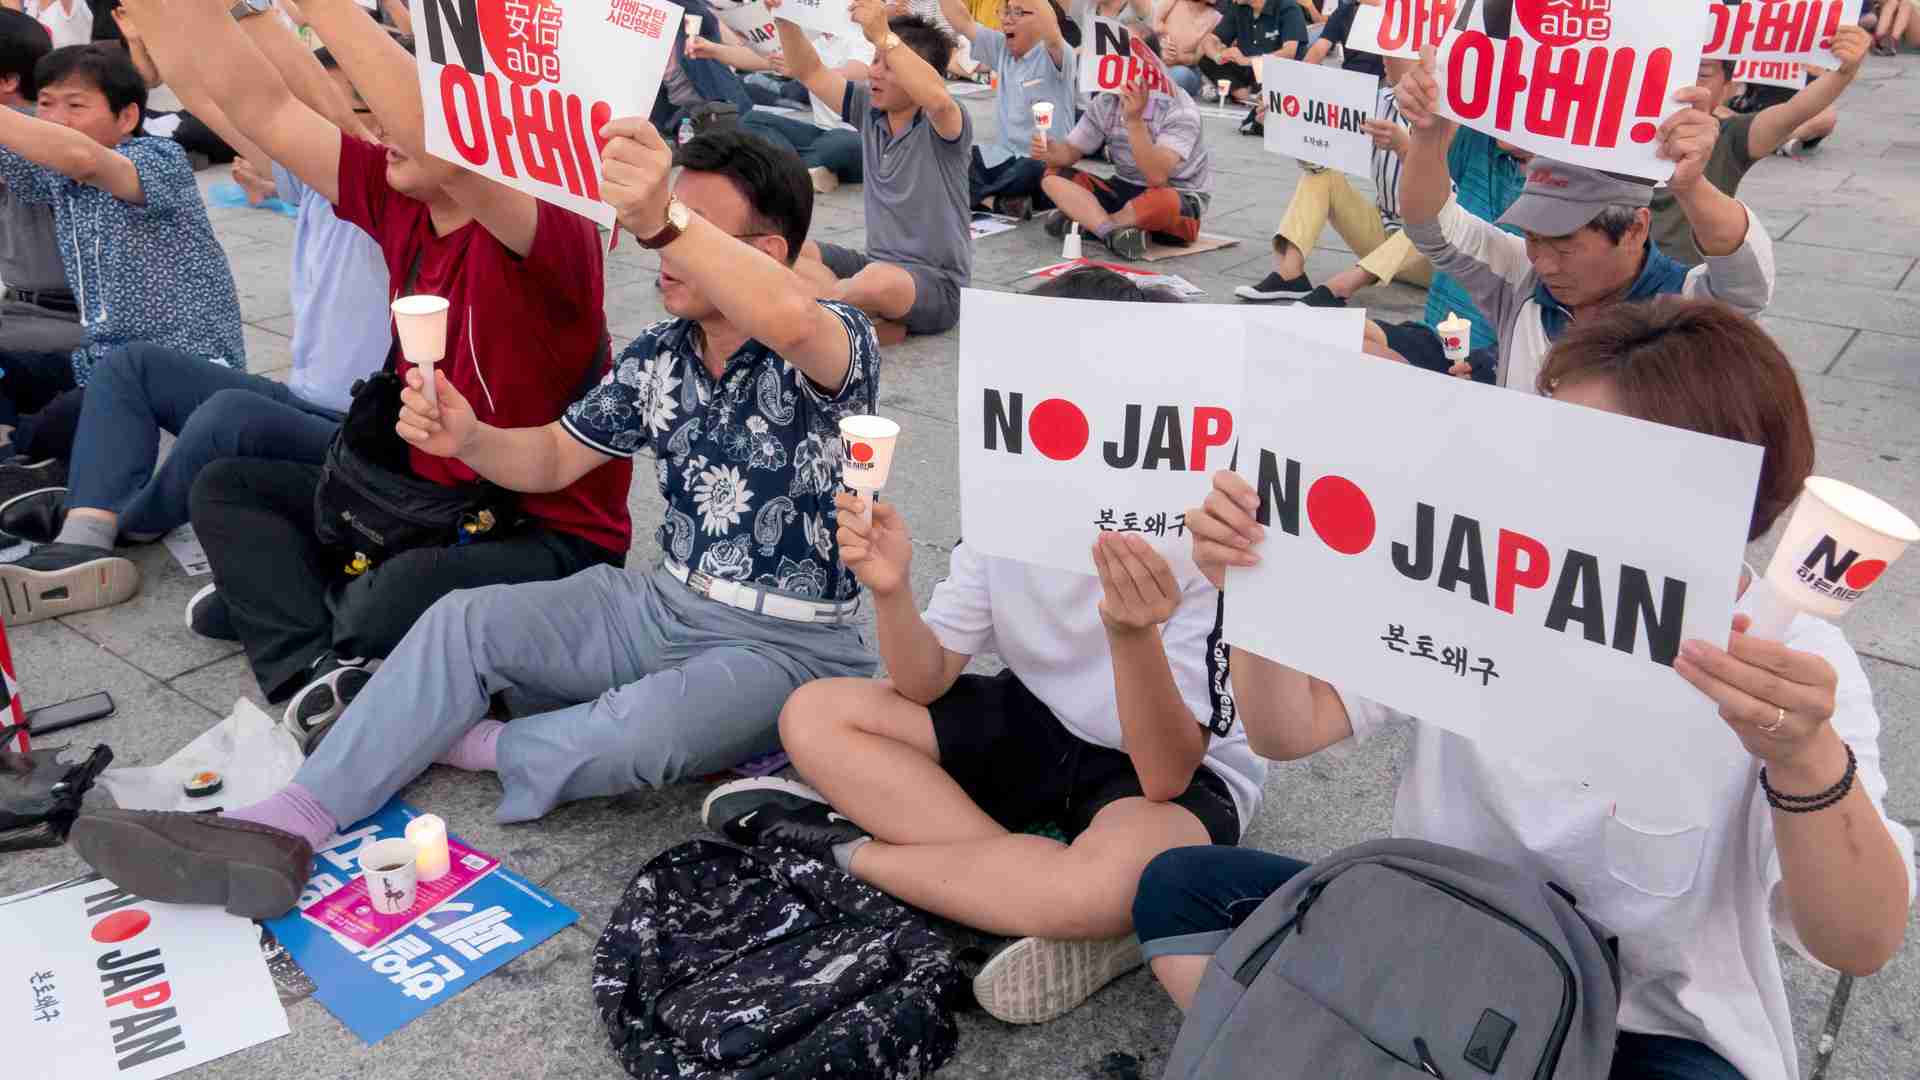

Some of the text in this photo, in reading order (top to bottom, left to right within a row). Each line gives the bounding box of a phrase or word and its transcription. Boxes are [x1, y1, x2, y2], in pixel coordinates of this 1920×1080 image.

[1540, 9, 1611, 39] abe
[506, 43, 562, 82] abe
[1447, 30, 1673, 148] 아베!
[1303, 98, 1367, 135] JAHAN
[1103, 403, 1239, 472] JAP
[1391, 502, 1687, 668] JAPAN
[1380, 623, 1500, 686] 본토왜구
[97, 948, 187, 1071] JAPAN
